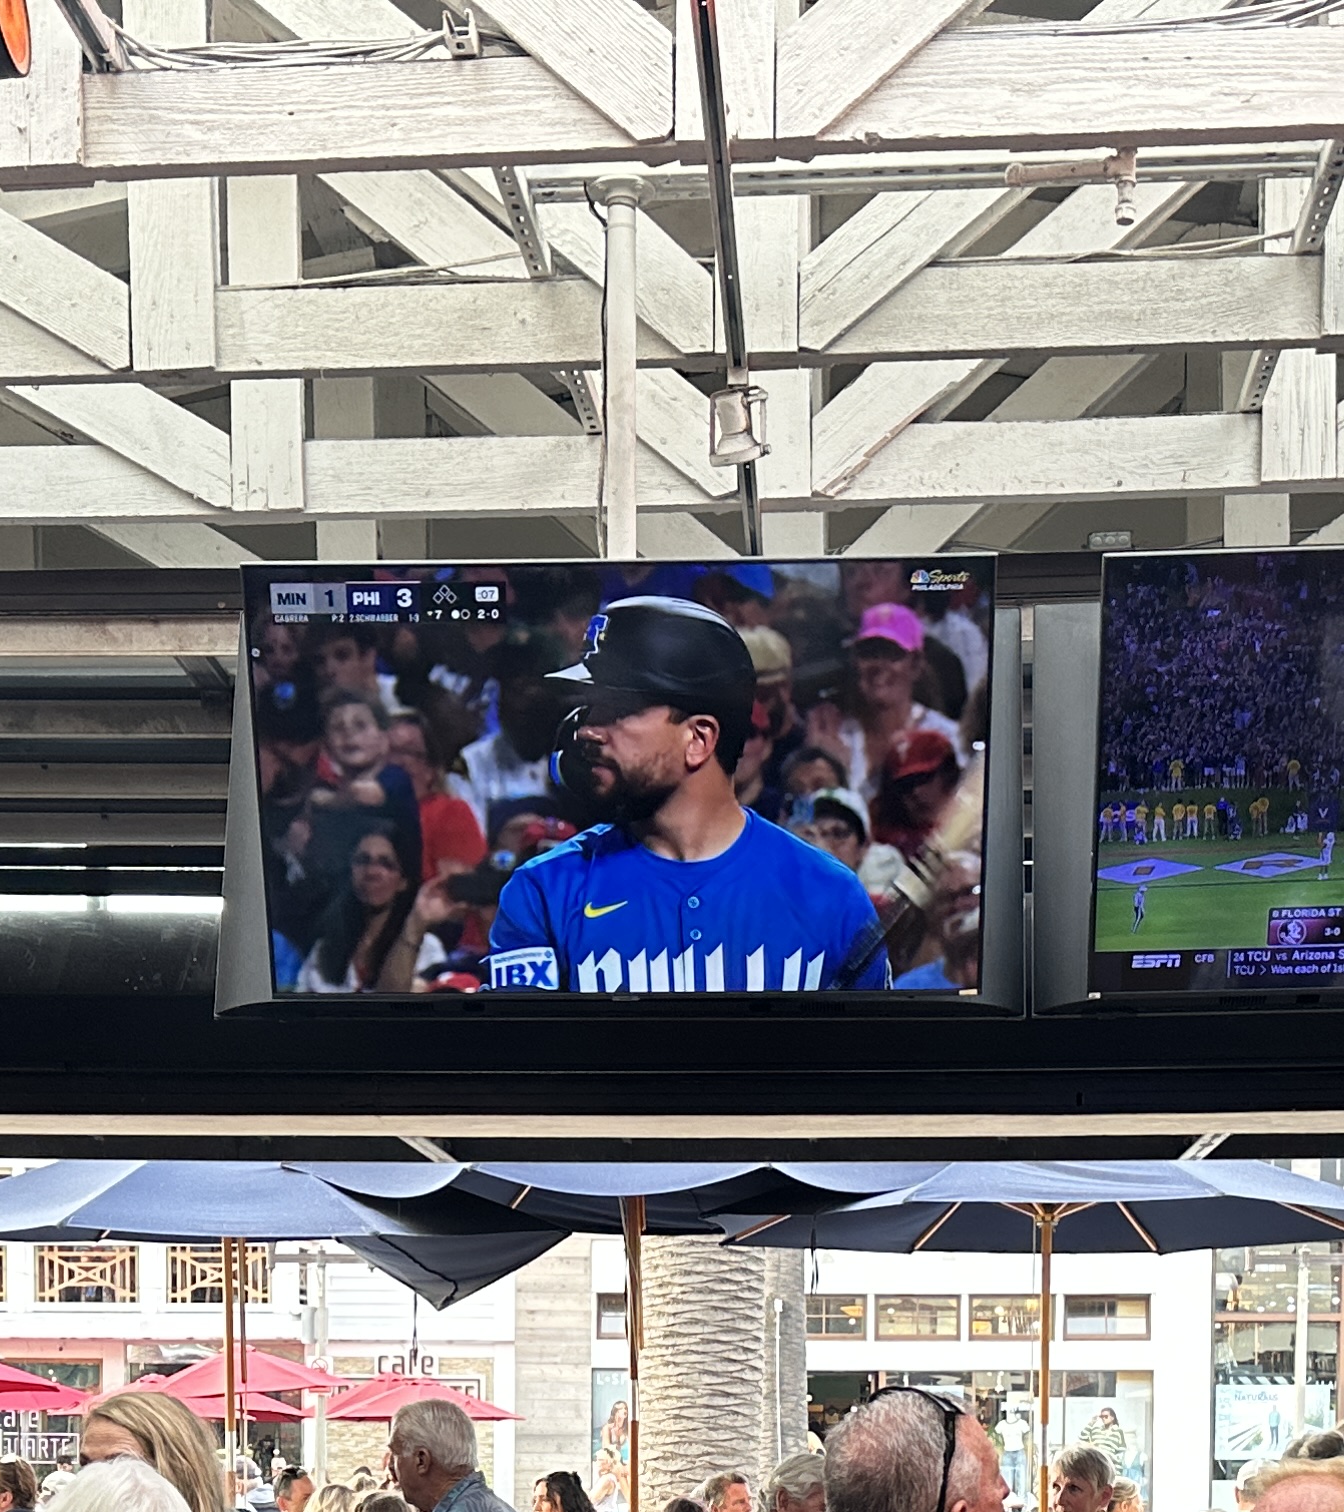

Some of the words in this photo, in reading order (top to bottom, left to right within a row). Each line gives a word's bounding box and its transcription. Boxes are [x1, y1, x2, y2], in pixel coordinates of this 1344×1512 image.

[277, 592, 306, 606] MIN
[324, 589, 334, 608] 1
[352, 591, 380, 606] PHI
[396, 588, 413, 608] 3
[477, 609, 500, 619] 2-0
[1281, 908, 1326, 918] FLORIDA
[1328, 907, 1343, 917] ST
[1324, 927, 1341, 936] 3-0
[1131, 953, 1181, 969] ESPN
[1194, 952, 1215, 963] CFB
[1247, 950, 1271, 962] TCU
[1276, 953, 1287, 961] vs
[1291, 949, 1336, 961] Arizona
[1234, 965, 1255, 975] TCU
[1271, 964, 1293, 975] Won
[1295, 963, 1319, 974] each
[1321, 962, 1332, 974] of
